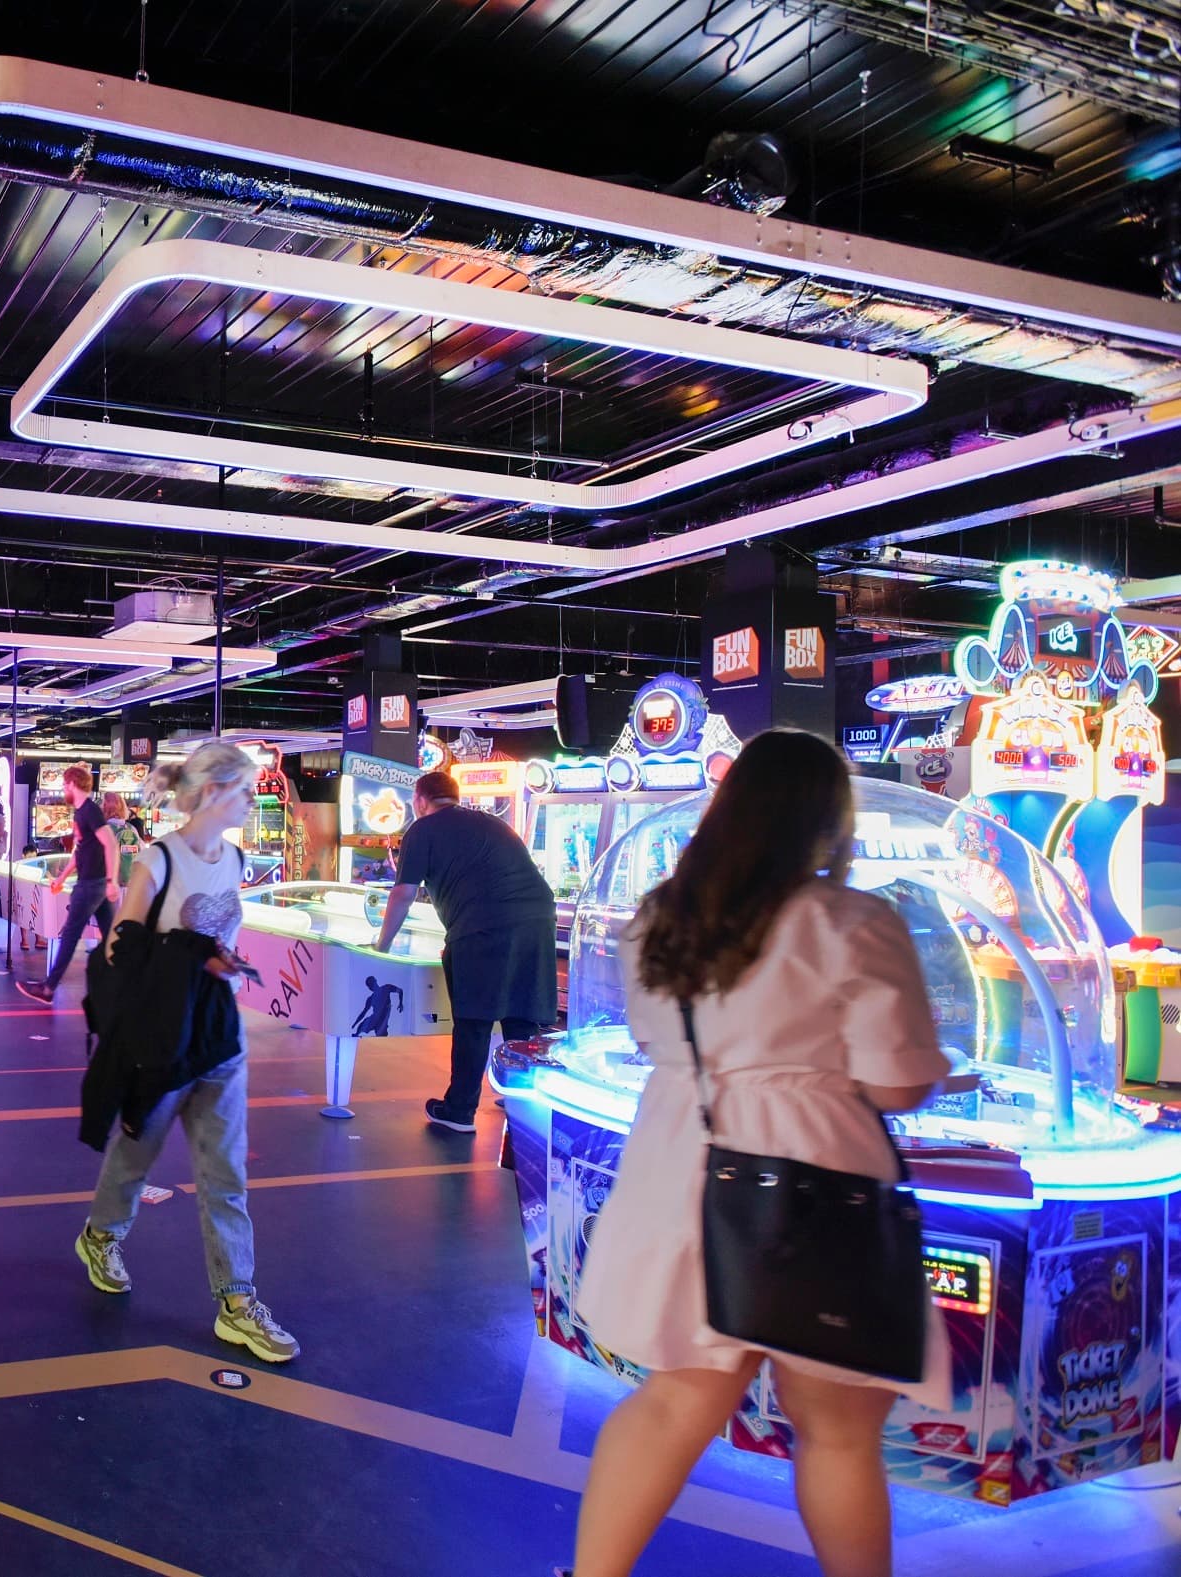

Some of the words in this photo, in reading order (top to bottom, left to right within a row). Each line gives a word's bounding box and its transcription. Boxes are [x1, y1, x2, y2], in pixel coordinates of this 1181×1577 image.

[714, 629, 750, 654] FUN
[785, 628, 817, 651] FUN
[713, 652, 749, 677] BOX
[785, 646, 816, 669] BOX
[348, 694, 364, 711] FUN
[381, 694, 405, 709] FUN
[348, 709, 363, 726] BOX
[381, 708, 404, 723] BOX
[652, 718, 675, 732] 373
[848, 729, 877, 742] 1000
[351, 758, 387, 780] ANGRY
[920, 759, 946, 776] ICE
[523, 1203, 545, 1221] 500
[1061, 1342, 1126, 1386] TICKET
[1064, 1380, 1120, 1424] DOME
